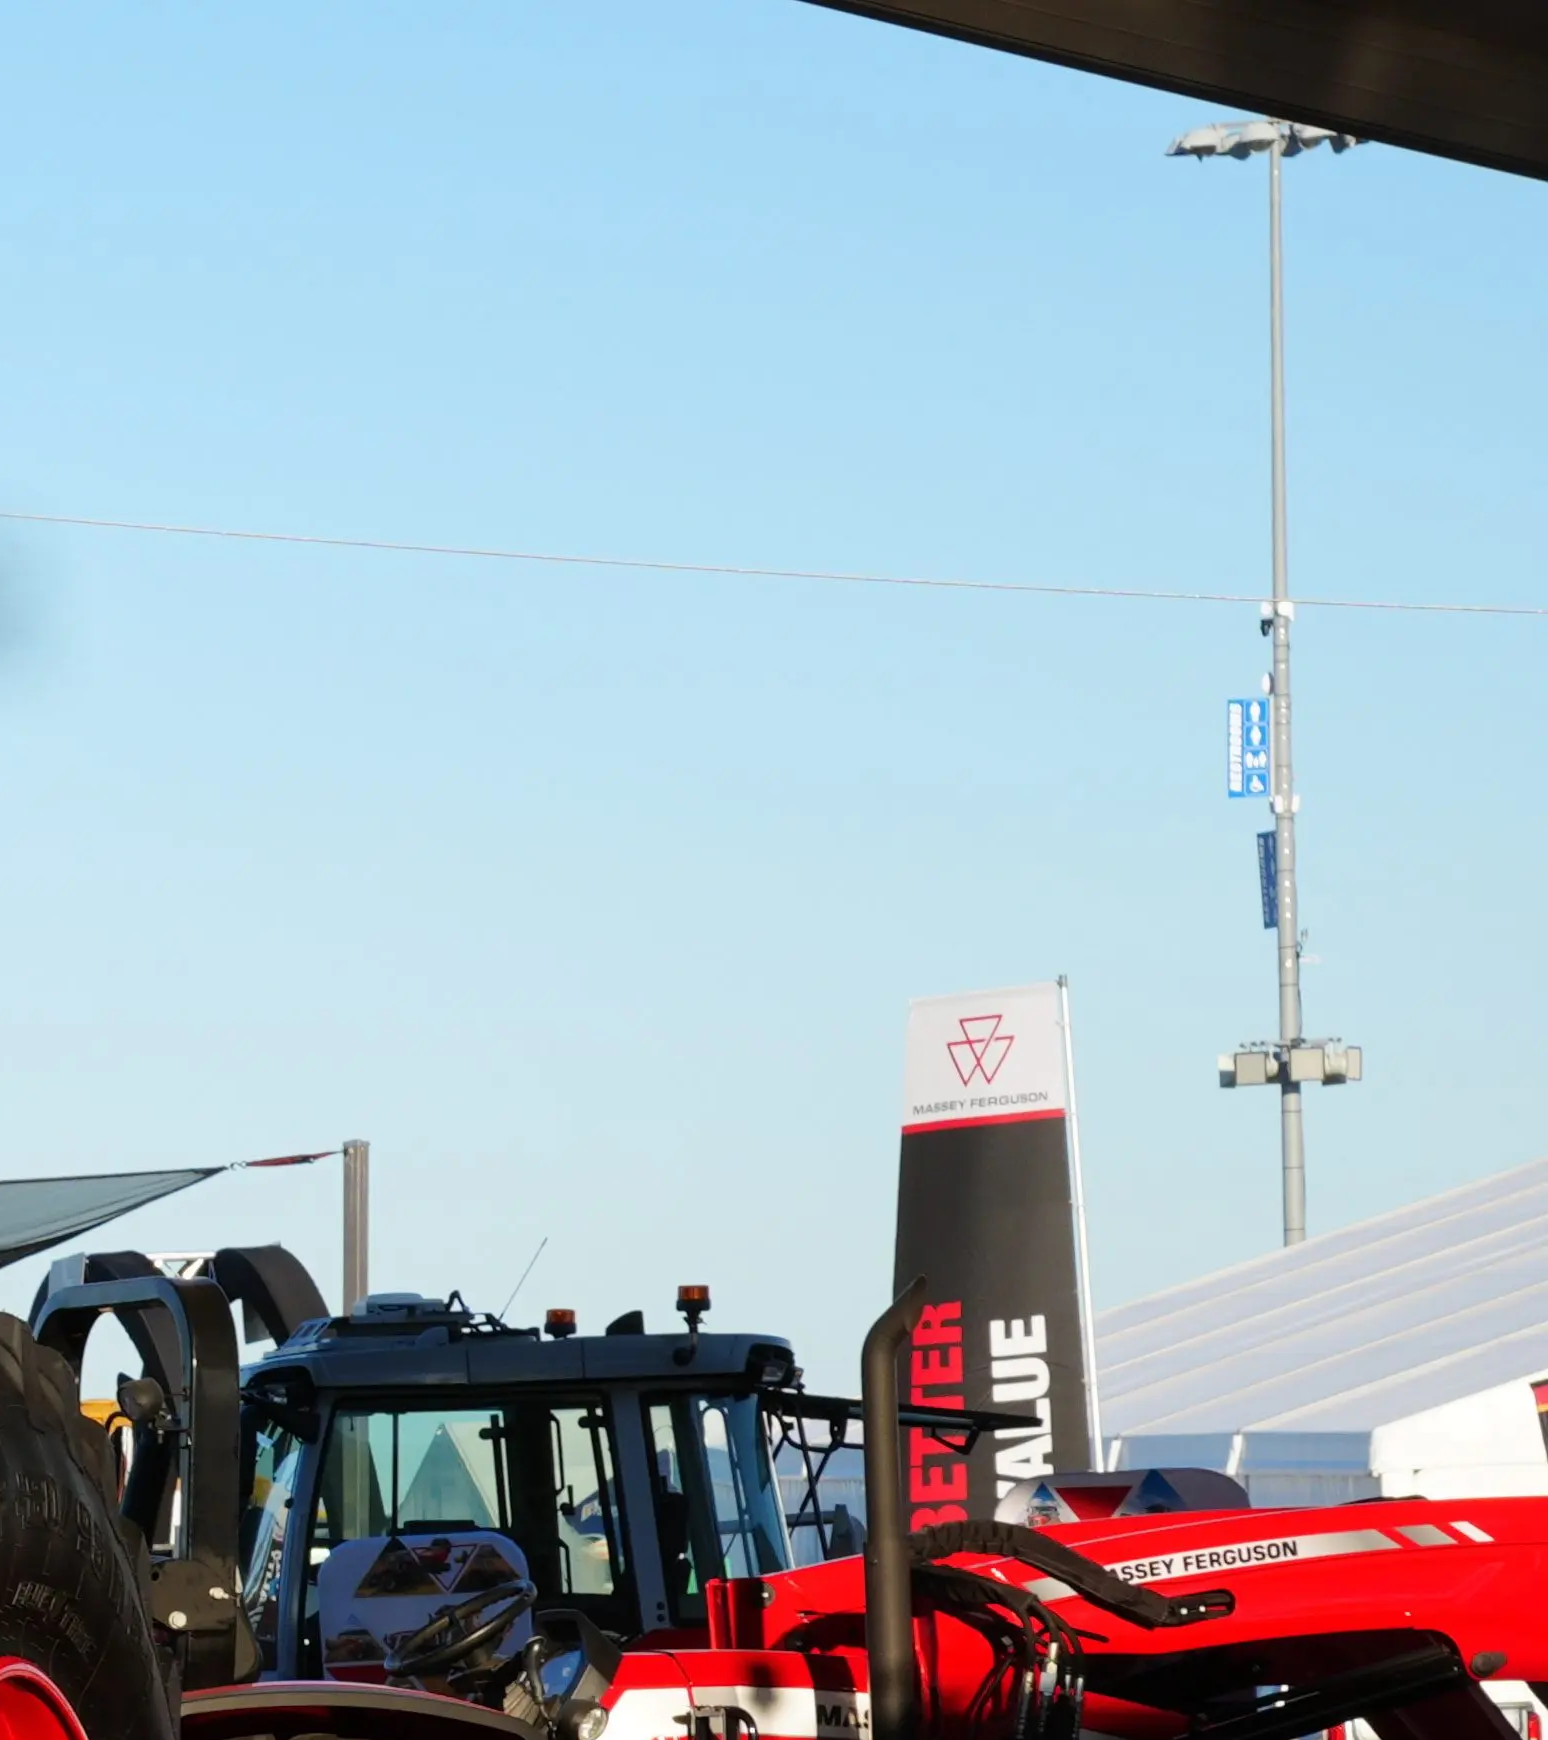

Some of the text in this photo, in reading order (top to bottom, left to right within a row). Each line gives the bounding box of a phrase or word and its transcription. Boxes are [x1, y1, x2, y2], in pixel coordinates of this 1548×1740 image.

[913, 1091, 1049, 1116] MASSEY FERGUSON
[989, 1315, 1054, 1499] ALUE
[1183, 1540, 1299, 1571] FERGUSON
